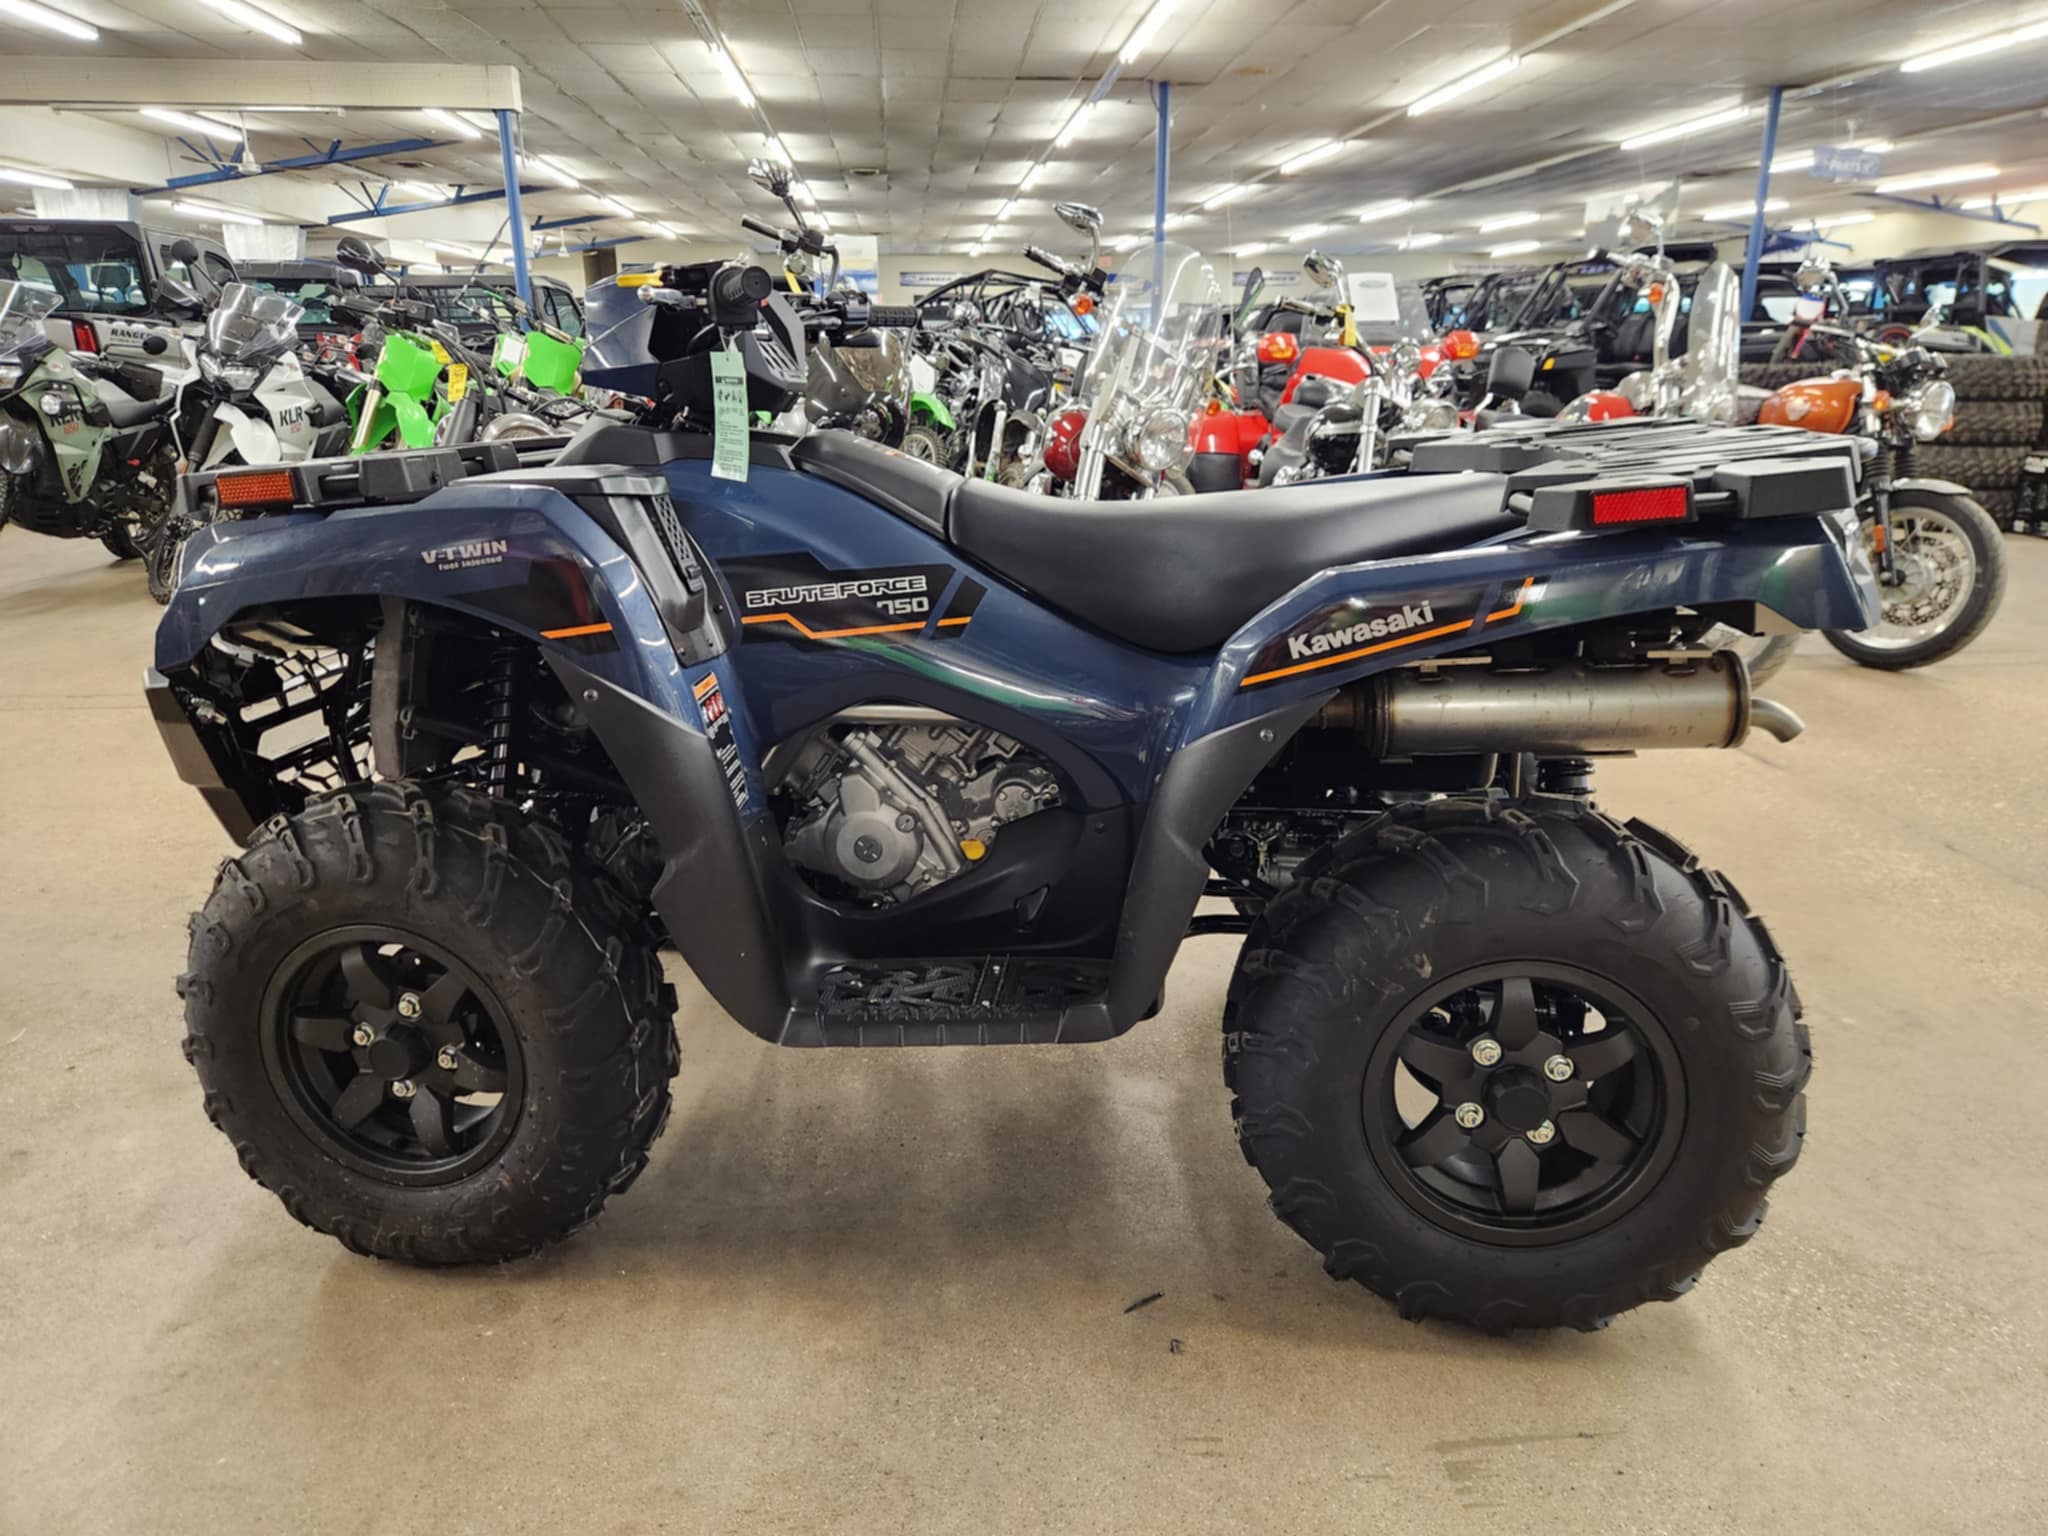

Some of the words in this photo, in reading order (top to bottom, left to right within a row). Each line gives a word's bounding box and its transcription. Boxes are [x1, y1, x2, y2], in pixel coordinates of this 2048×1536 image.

[280, 406, 303, 427] KLR
[421, 540, 507, 564] V-TWIN
[877, 596, 930, 615] 750
[1288, 600, 1434, 660] Kawasaki
